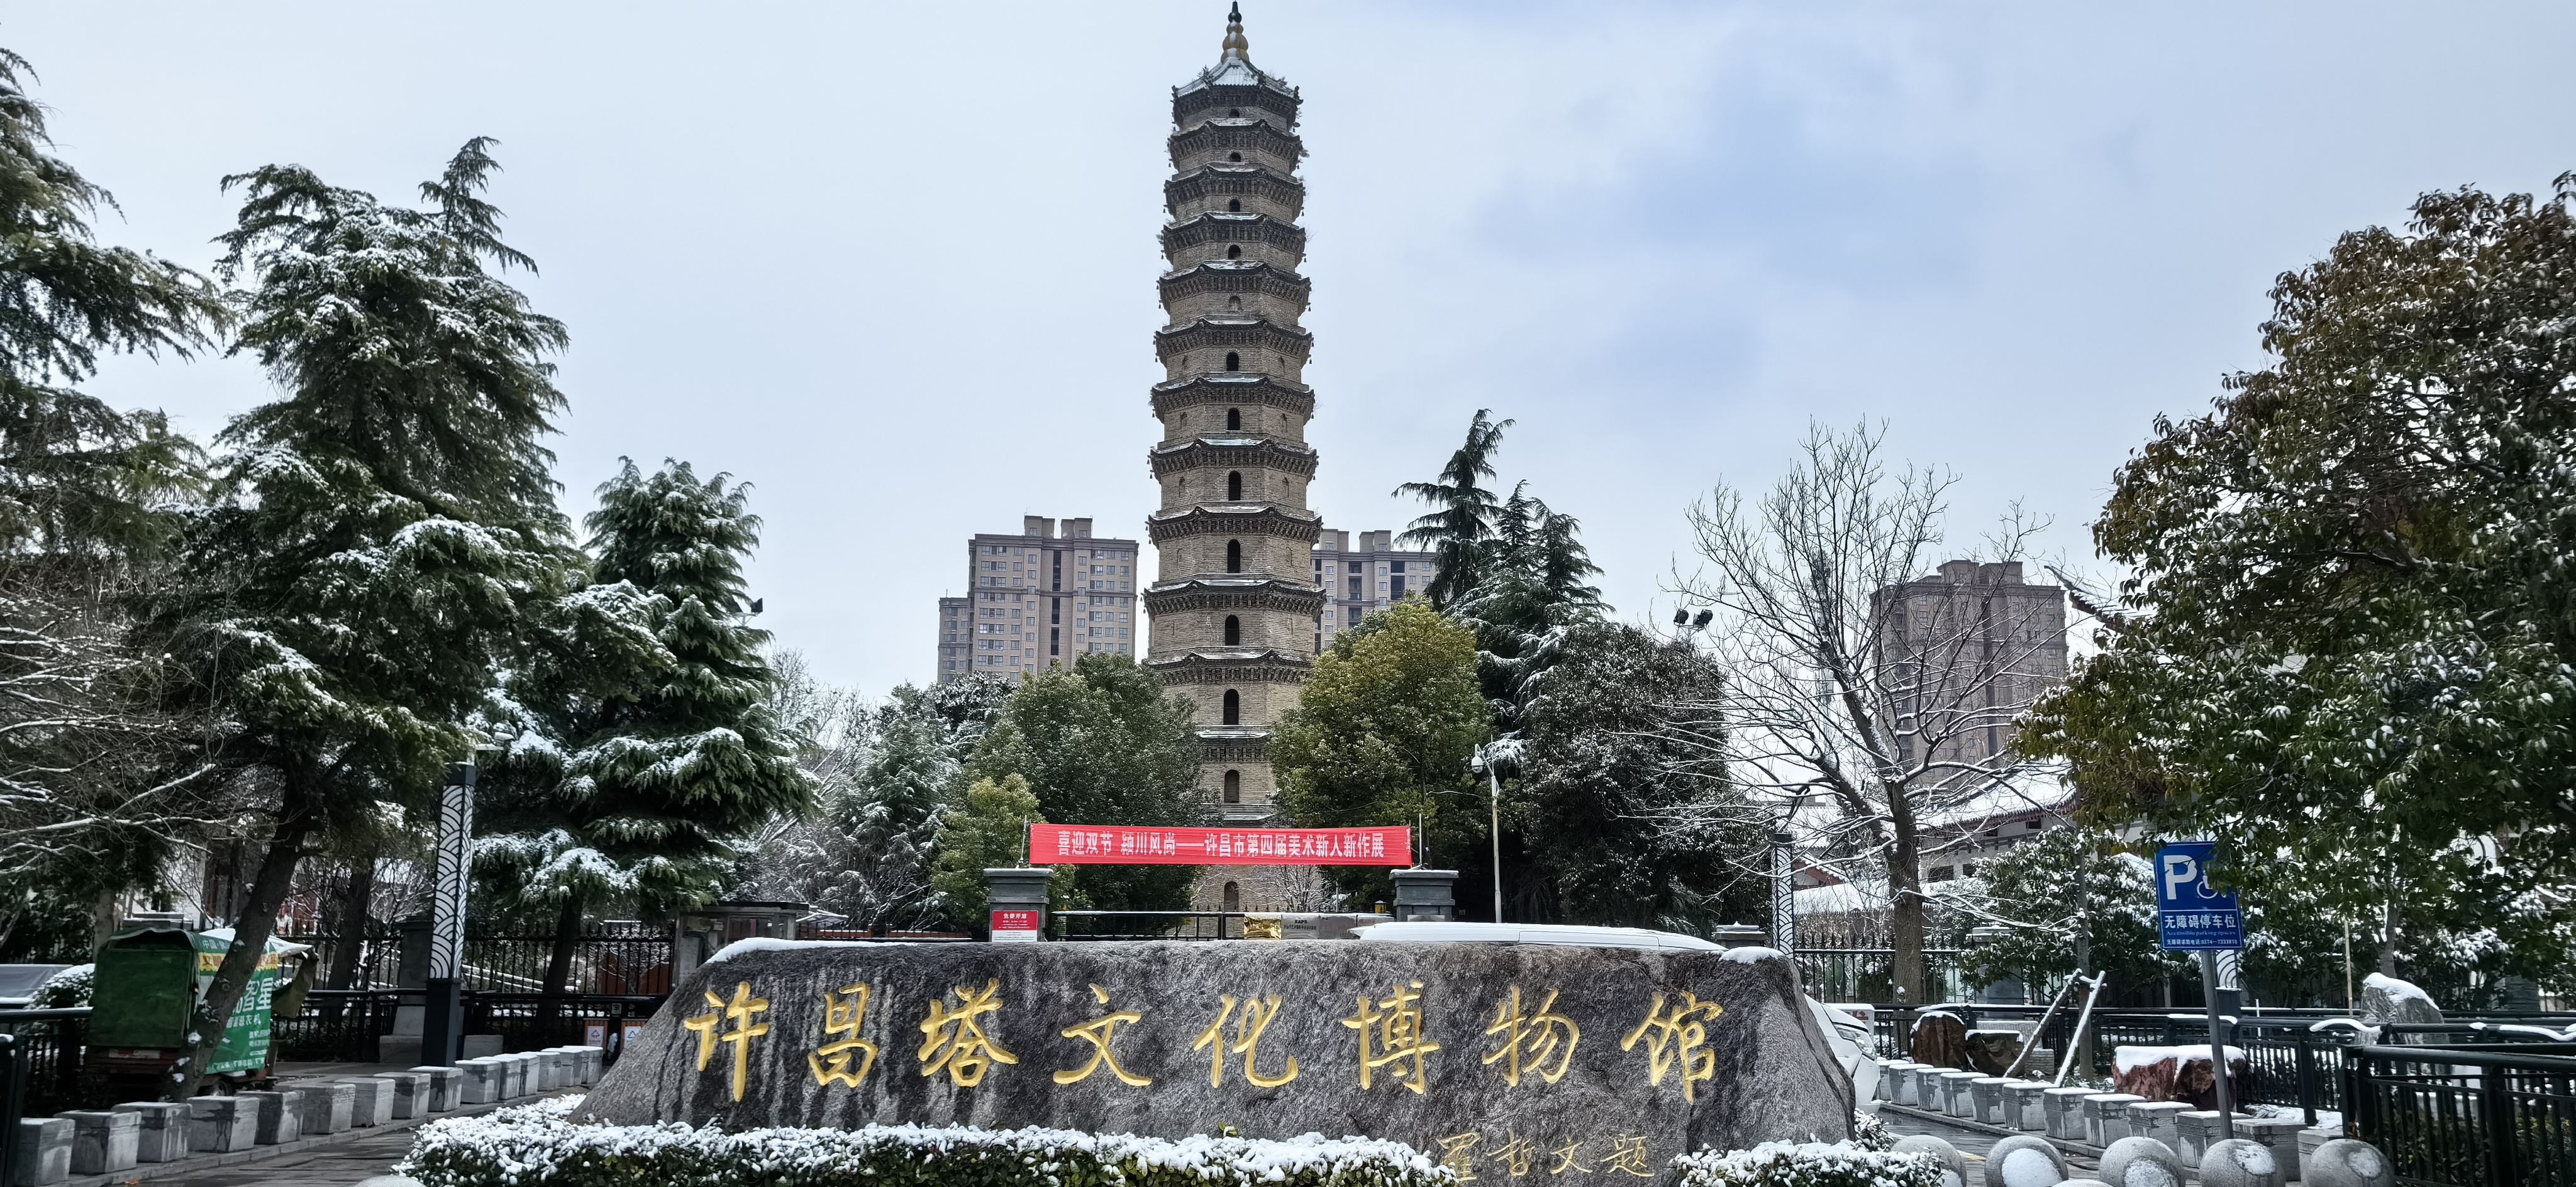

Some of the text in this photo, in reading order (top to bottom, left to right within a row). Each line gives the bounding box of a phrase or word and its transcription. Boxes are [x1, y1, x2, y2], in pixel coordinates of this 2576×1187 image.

[1057, 830, 1113, 856] 喜迎双节
[2163, 854, 2198, 900] P
[2164, 914, 2237, 929] 无障碍停车位
[684, 978, 1723, 1105] 许昌塔文化博物馆
